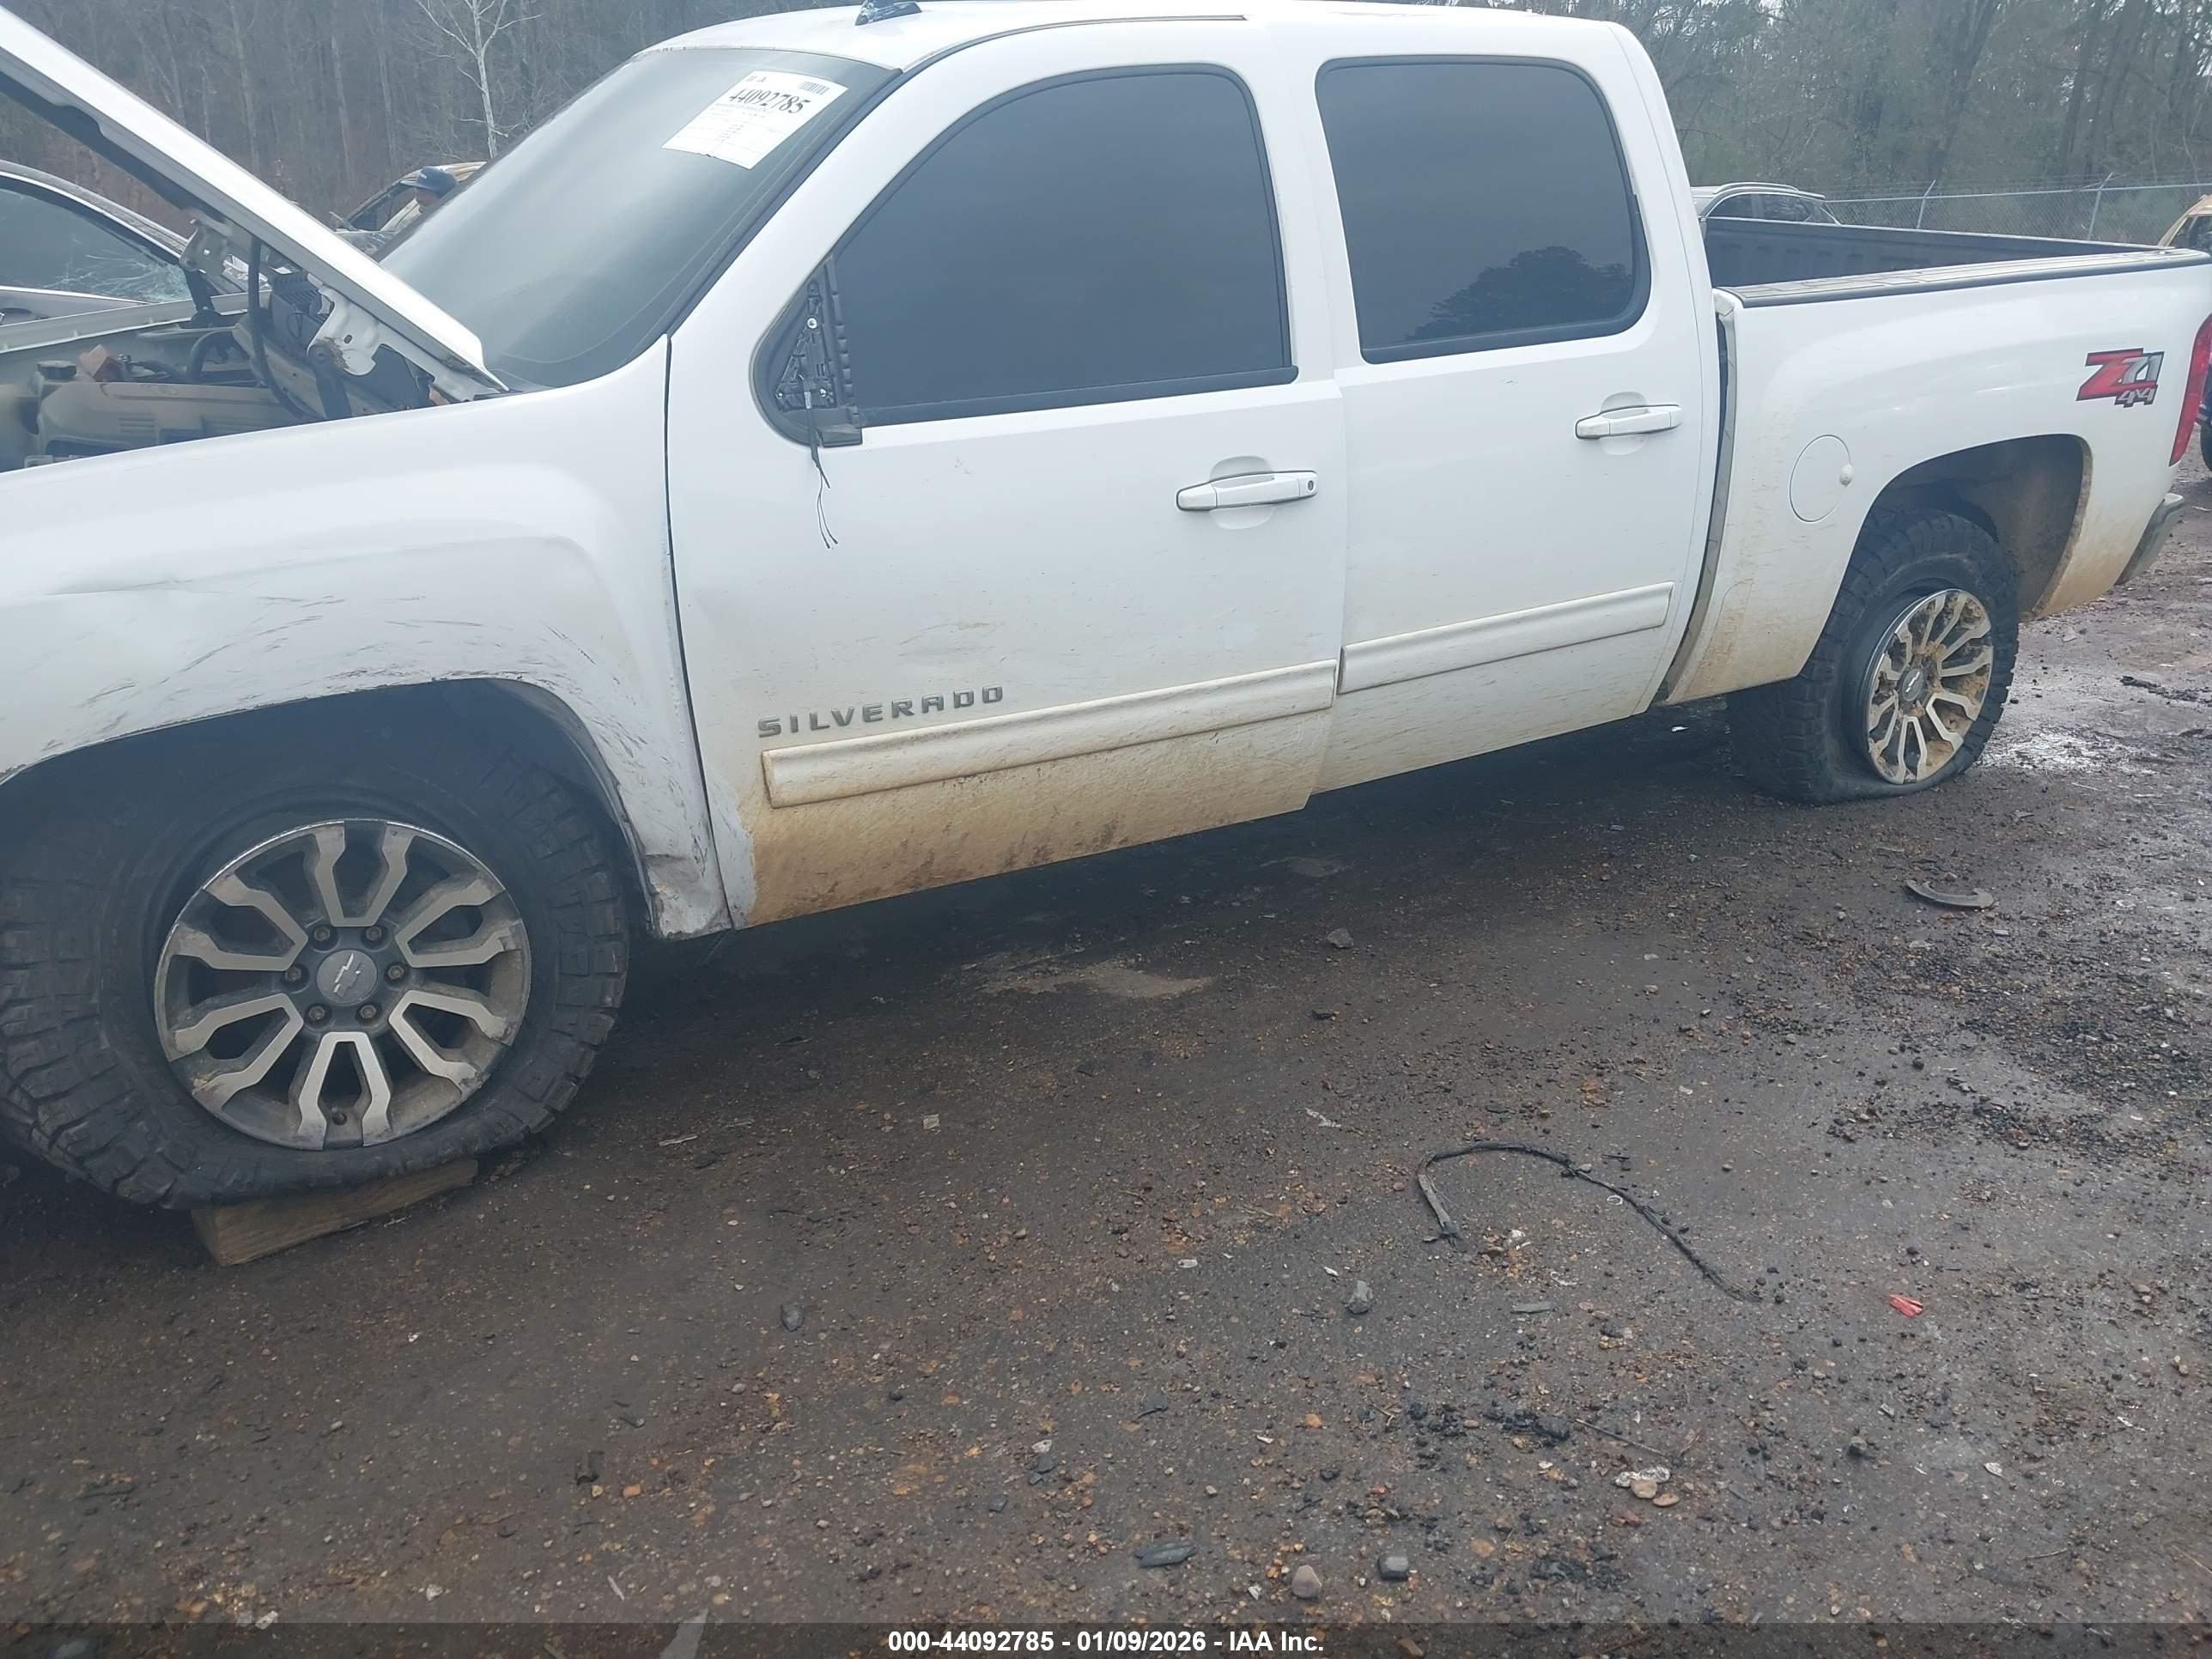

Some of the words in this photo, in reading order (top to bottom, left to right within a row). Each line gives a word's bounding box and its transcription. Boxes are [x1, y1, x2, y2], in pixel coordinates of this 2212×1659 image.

[729, 88, 811, 114] 44092785
[2076, 348, 2164, 401] Z71
[757, 684, 1005, 738] SILVERADO
